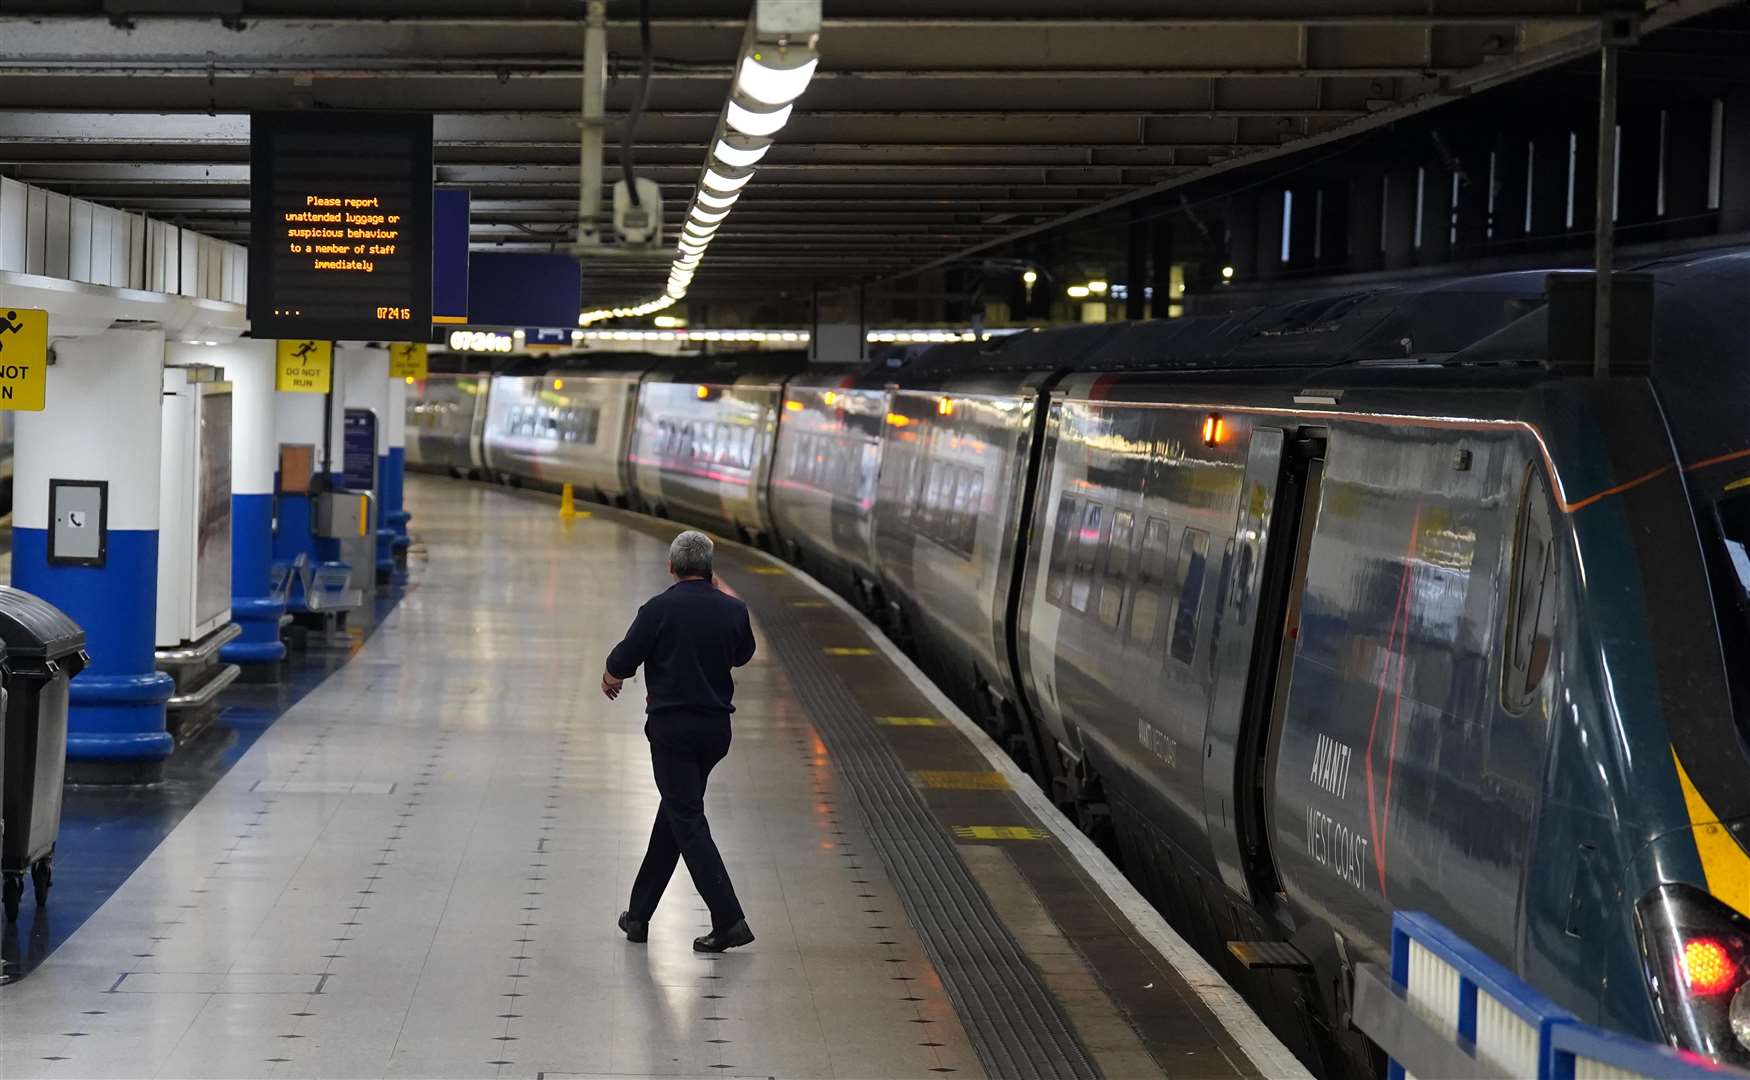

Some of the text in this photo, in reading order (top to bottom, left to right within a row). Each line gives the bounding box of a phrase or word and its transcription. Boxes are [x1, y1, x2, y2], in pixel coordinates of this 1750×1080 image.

[307, 196, 378, 209] Please report
[286, 212, 341, 222] unattended
[346, 213, 384, 225] luggage
[288, 228, 398, 239] suspicious behaviour
[290, 243, 301, 253] to
[316, 244, 350, 254] member
[354, 245, 365, 254] of
[369, 245, 395, 254] staff
[314, 259, 373, 272] immediately
[286, 368, 320, 376] DO NOT
[293, 379, 313, 387] RUN
[1310, 733, 1352, 799] AVANTI
[1306, 805, 1368, 892] WEST COAST
